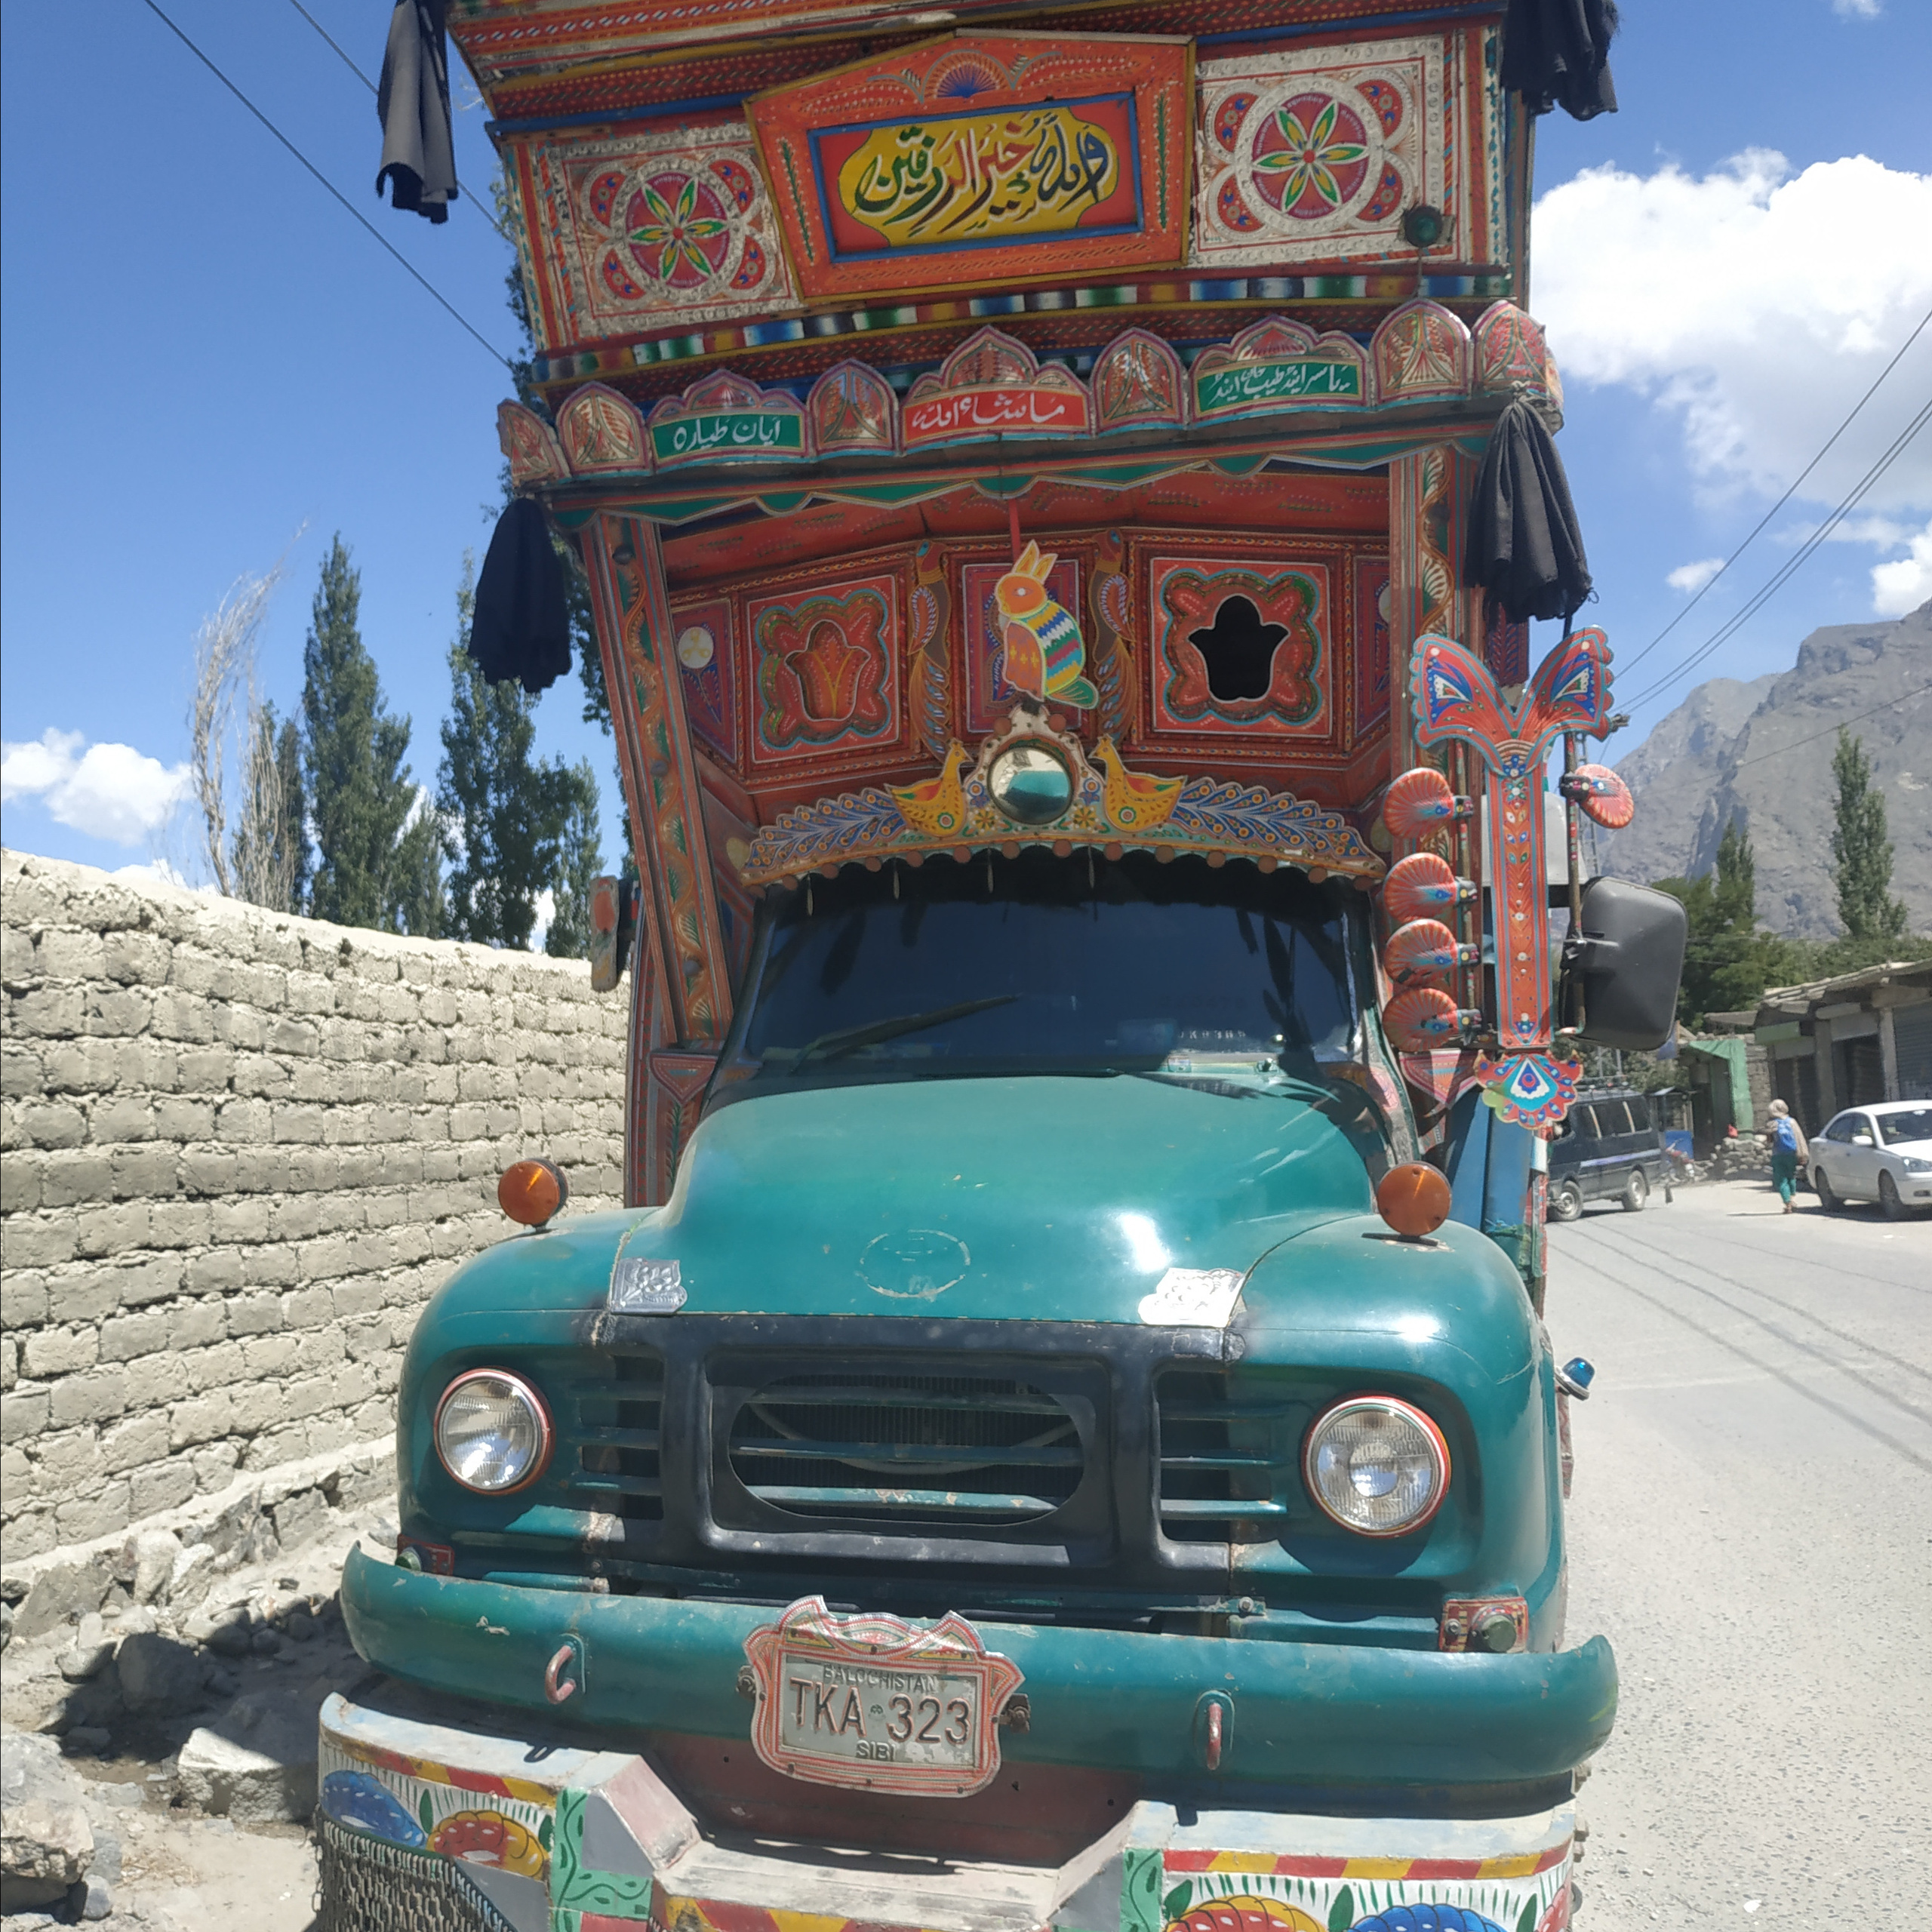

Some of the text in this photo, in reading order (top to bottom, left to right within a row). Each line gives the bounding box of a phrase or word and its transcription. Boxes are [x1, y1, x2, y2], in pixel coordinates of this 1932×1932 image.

[823, 1663, 940, 1694] BALOCHISTAN
[789, 1677, 974, 1745] TKA 323
[855, 1739, 897, 1761] SIBI
